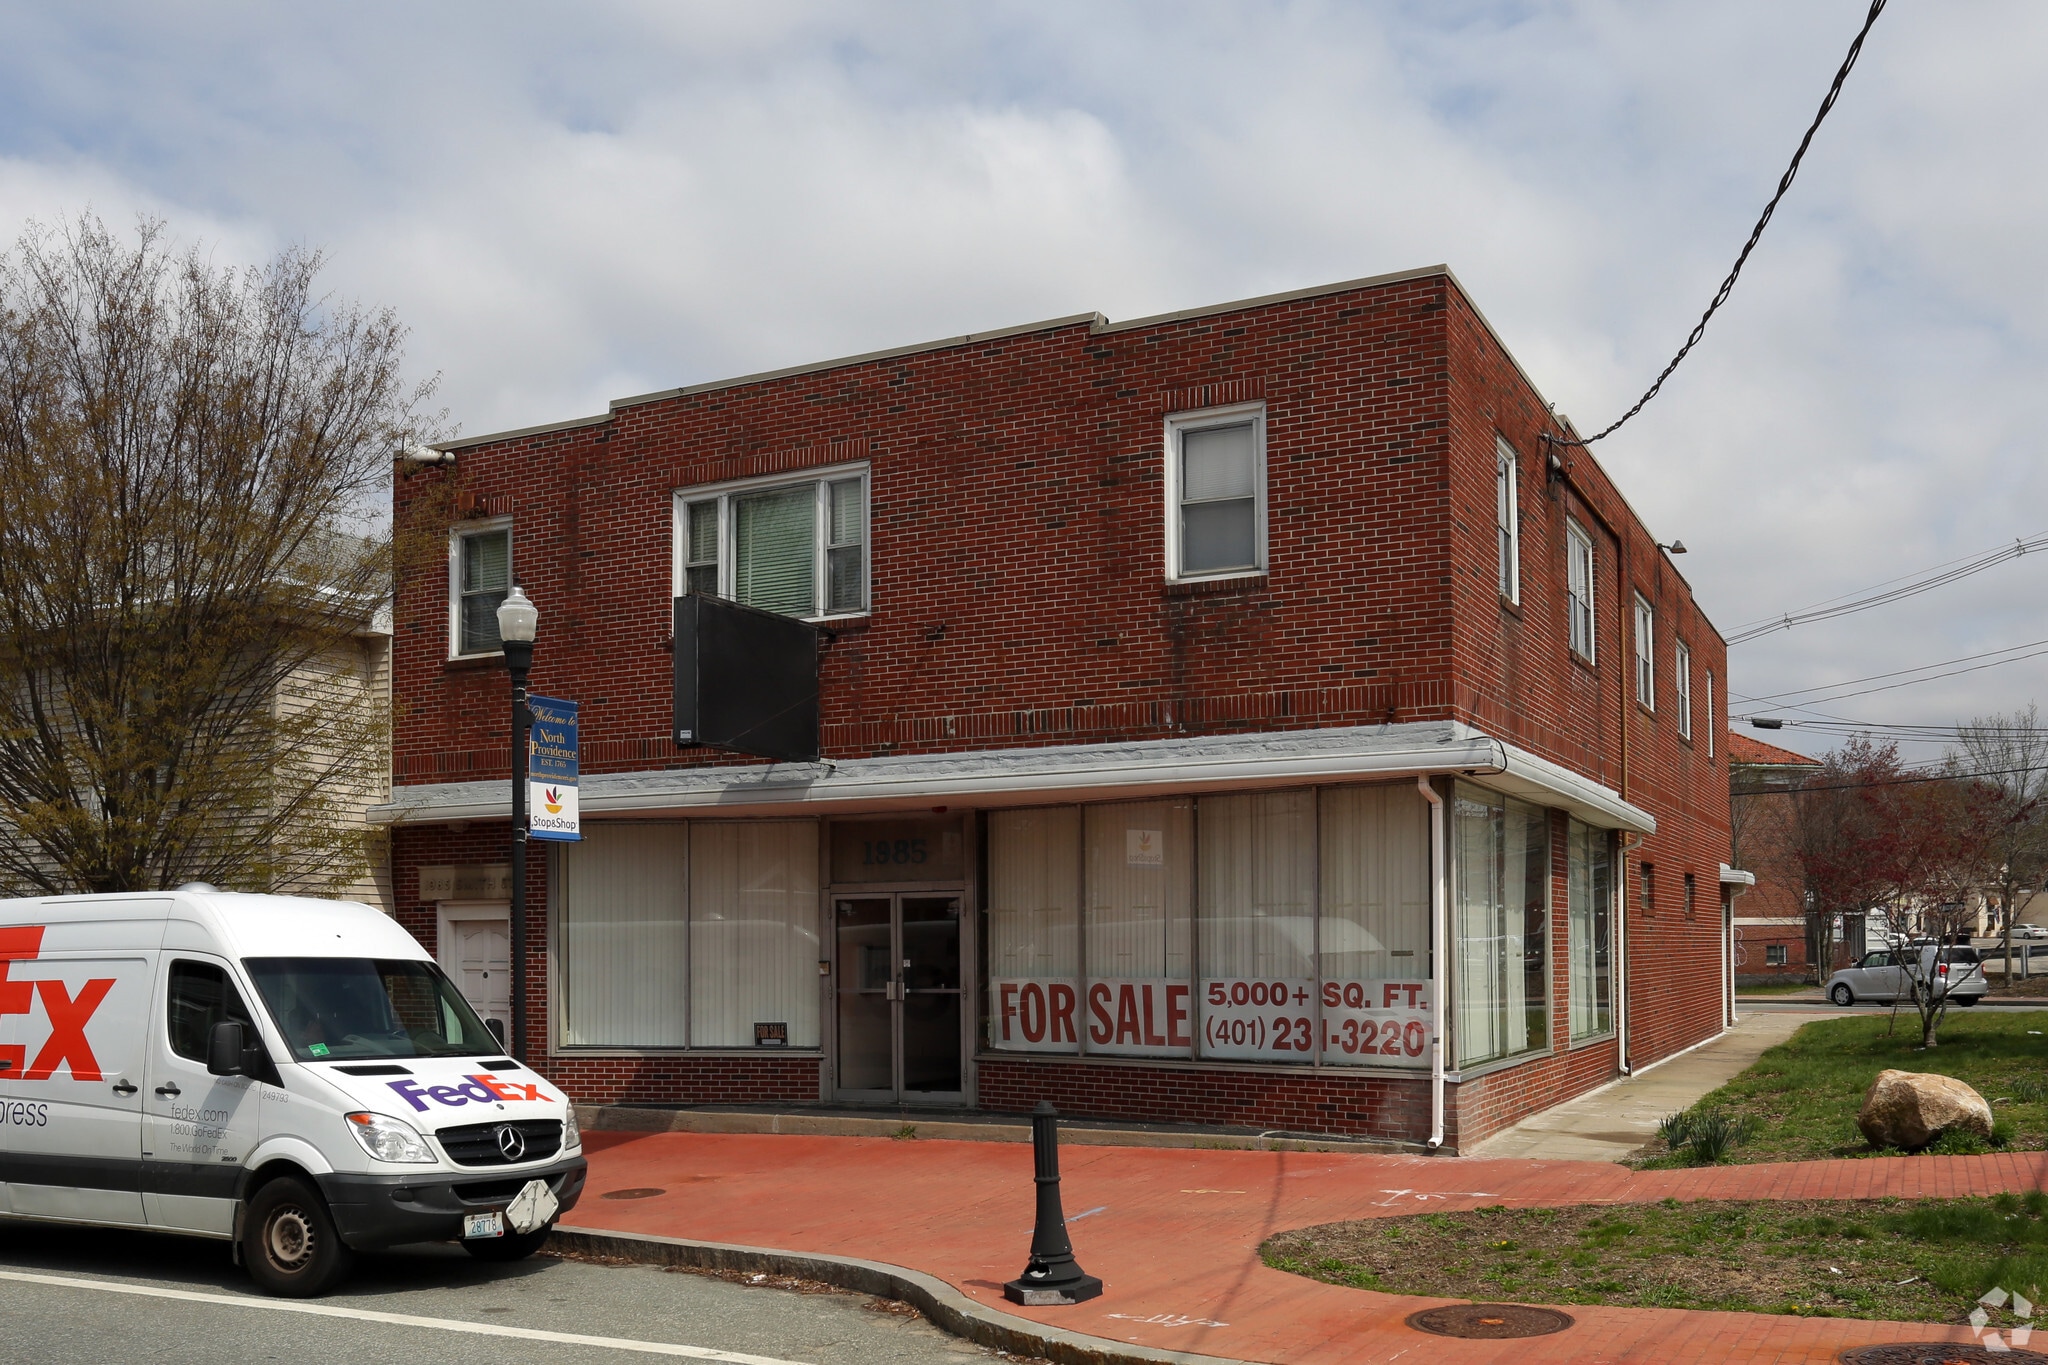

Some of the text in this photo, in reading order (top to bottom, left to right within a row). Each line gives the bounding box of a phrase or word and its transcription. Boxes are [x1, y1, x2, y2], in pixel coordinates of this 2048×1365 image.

[532, 705, 576, 726] Welcome to
[540, 728, 566, 744] North
[531, 741, 577, 759] Providence
[554, 759, 567, 768] 1765
[533, 815, 577, 831] Stop&Shop
[863, 838, 928, 865] 1985
[1322, 982, 1371, 1009] SQ.
[1383, 983, 1427, 1009] FT.
[1000, 983, 1191, 1046] FOR SALE
[756, 1025, 785, 1039] FOR SALE
[1206, 1015, 1266, 1049] (401)
[262, 1090, 289, 1103] 249793
[384, 1074, 556, 1113] FedEx
[171, 1103, 229, 1122] fedex.com
[169, 1123, 228, 1140] 1.800.GoFedEx
[170, 1142, 229, 1156] The World On Time
[471, 1219, 497, 1234] 28778
